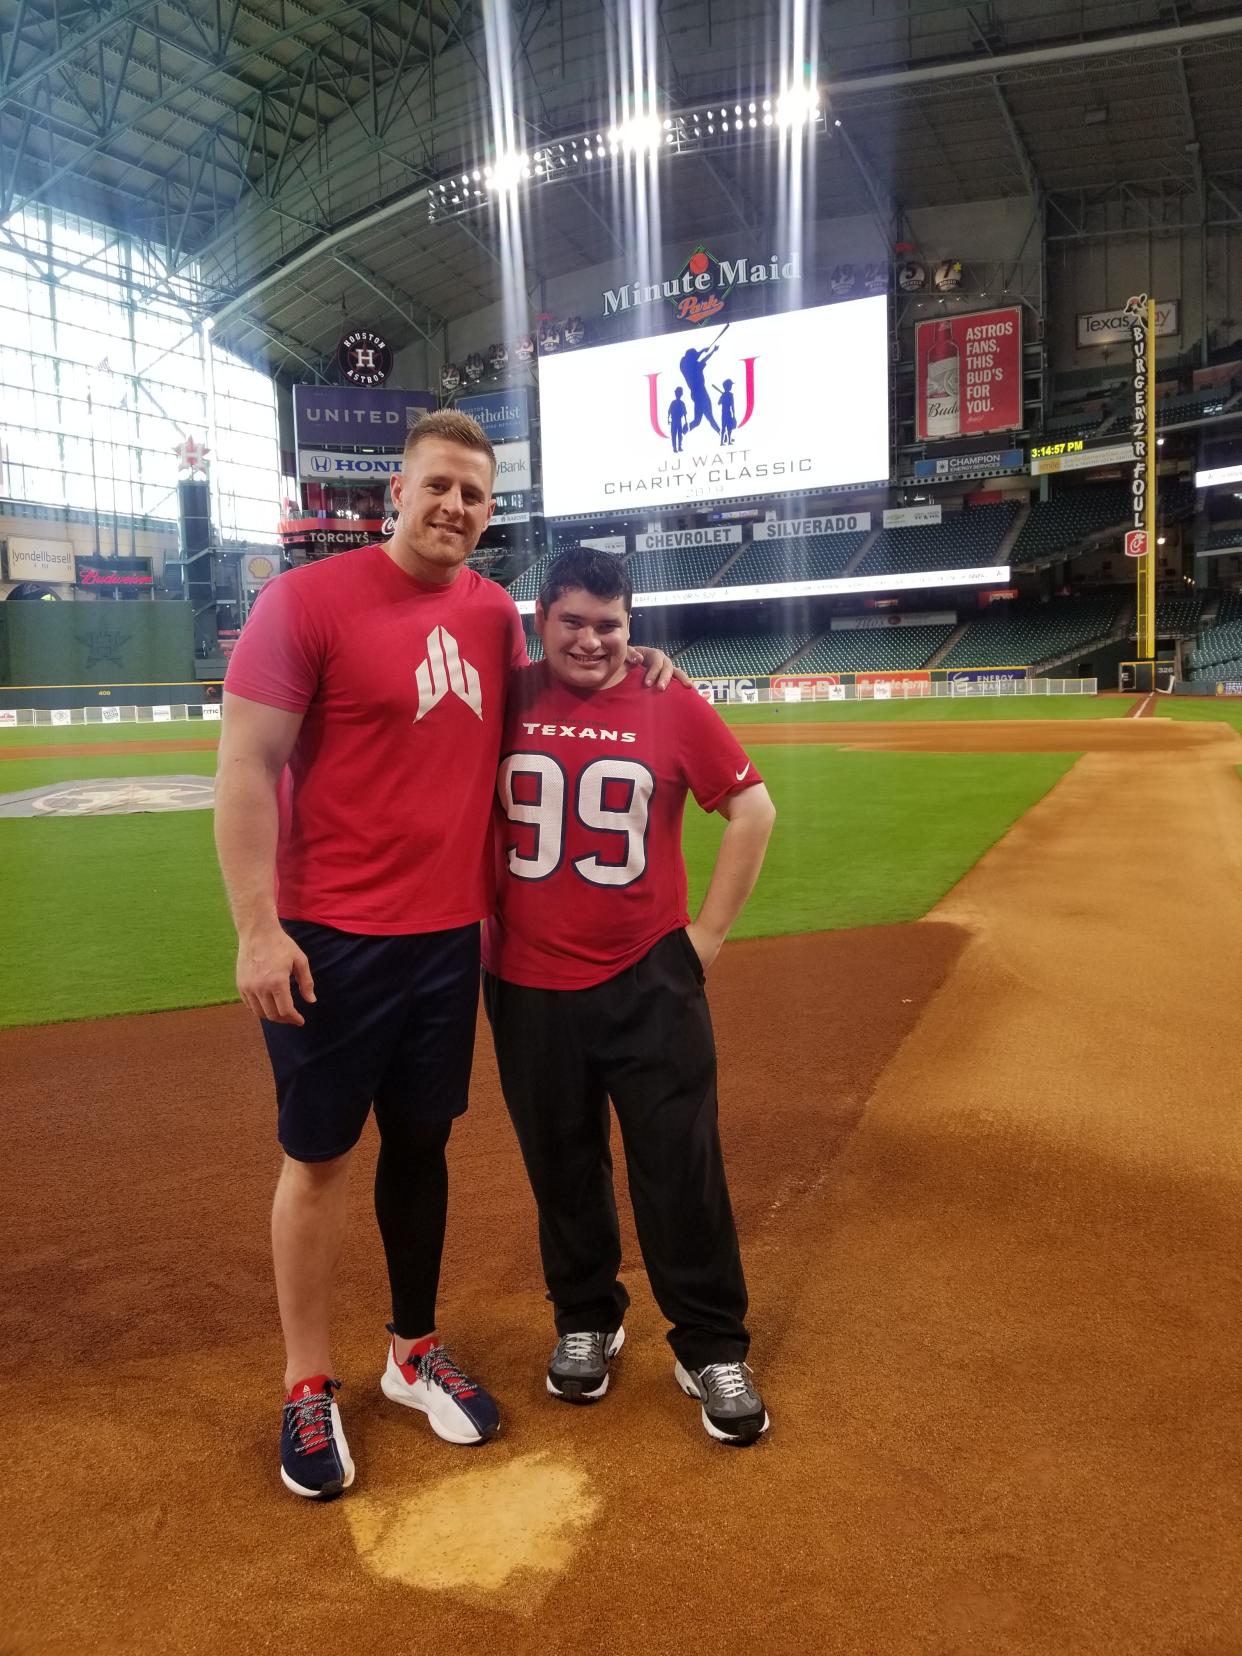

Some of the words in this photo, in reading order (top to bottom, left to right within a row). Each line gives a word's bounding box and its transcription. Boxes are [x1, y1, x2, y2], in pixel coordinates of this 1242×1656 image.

[603, 271, 711, 316] Minute
[718, 252, 801, 287] Maid
[677, 295, 724, 321] Park
[966, 321, 1013, 341] ASTROS
[343, 332, 386, 349] HOUSTON
[966, 339, 1000, 355] FANS,
[355, 348, 375, 368] H
[966, 354, 994, 370] THIS
[347, 370, 385, 384] ASTROS
[966, 368, 1003, 385] BUD'S
[966, 384, 990, 399] FOR
[472, 404, 521, 424] ethodist
[966, 398, 994, 414] YOU.
[306, 408, 400, 424] UNITED
[1031, 443, 1066, 458] 3:14:57
[1067, 440, 1083, 452] PM
[658, 459, 682, 472] JJ
[693, 449, 751, 468] WATT
[950, 453, 1001, 467] CHAMPION
[495, 460, 525, 477] yBank
[708, 458, 813, 483] CLASSIC
[604, 472, 697, 495] CHARITY
[1132, 462, 1146, 528] FOUL
[767, 515, 858, 538] SILVERADO
[645, 528, 732, 549] CHEVROLET
[12, 549, 71, 565] lyondellbasell
[977, 674, 1014, 683] ENERGY
[522, 722, 637, 743] TEXANS
[496, 752, 656, 889] 99
